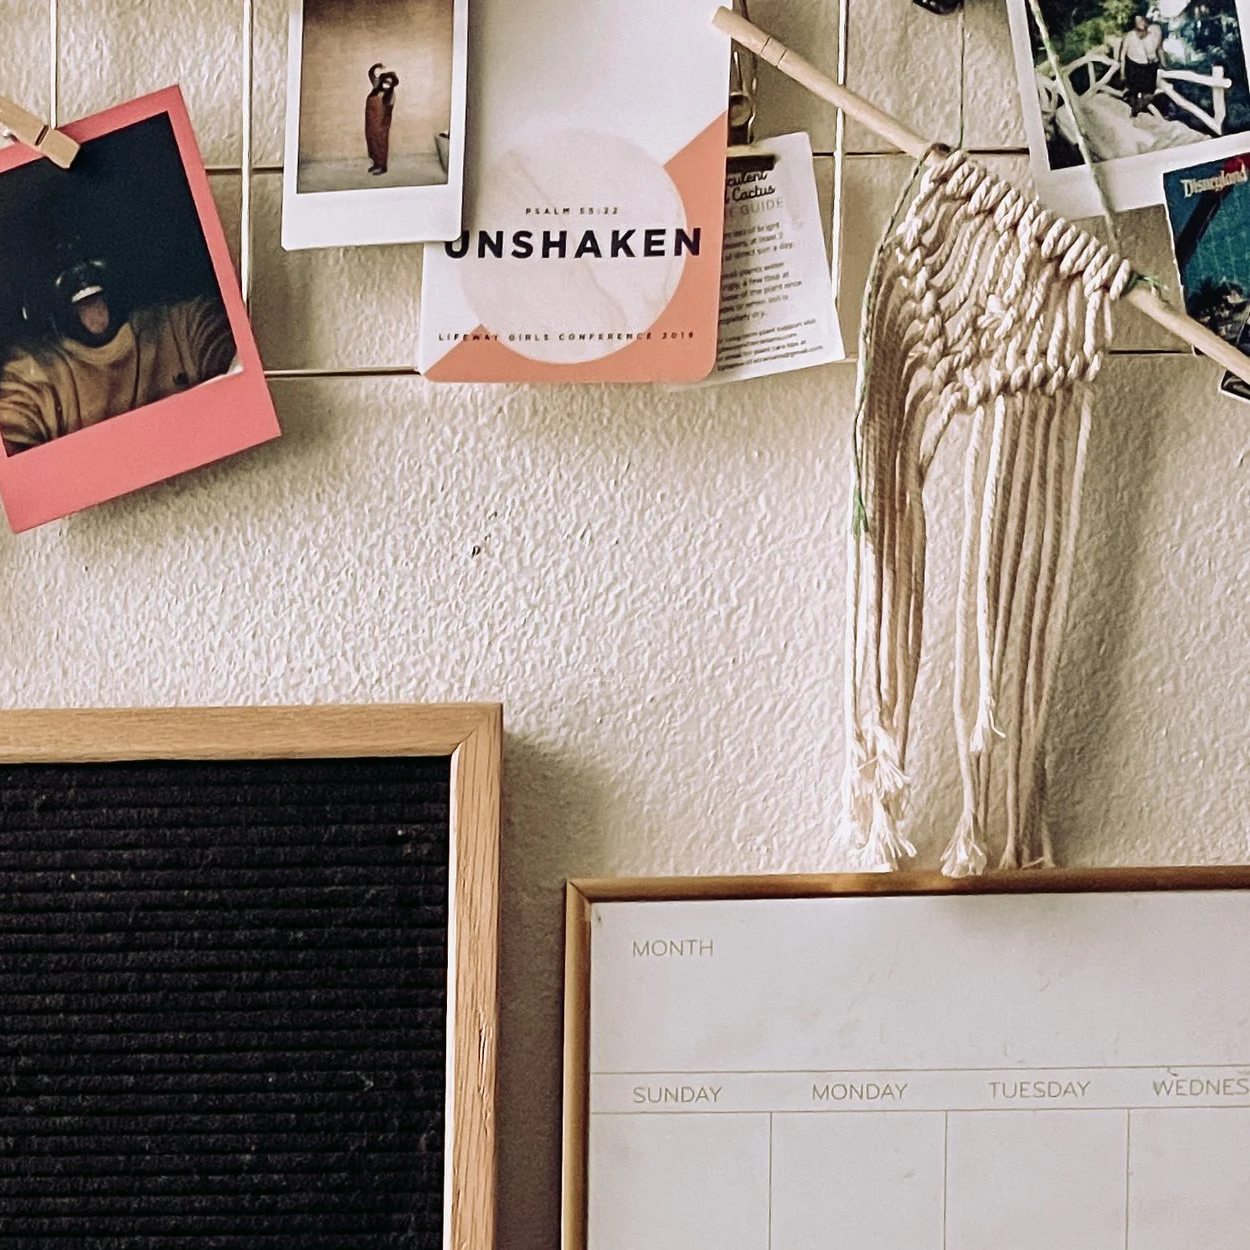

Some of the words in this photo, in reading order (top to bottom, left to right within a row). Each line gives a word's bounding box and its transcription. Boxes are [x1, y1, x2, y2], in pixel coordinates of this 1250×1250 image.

[1179, 158, 1248, 199] Disneyland
[731, 184, 776, 202] Cactus
[525, 207, 570, 216] PSALM
[740, 197, 783, 215] GUIDE
[444, 227, 702, 259] UNSHAKEN
[438, 332, 499, 342] LIFEWAY
[507, 332, 550, 342] GIRLS
[558, 331, 653, 342] CONFERENCE
[632, 939, 715, 957] MONTH
[633, 1086, 723, 1104] SUNDAY
[812, 1083, 909, 1101] MONDAY
[989, 1081, 1091, 1099] TUESDAY
